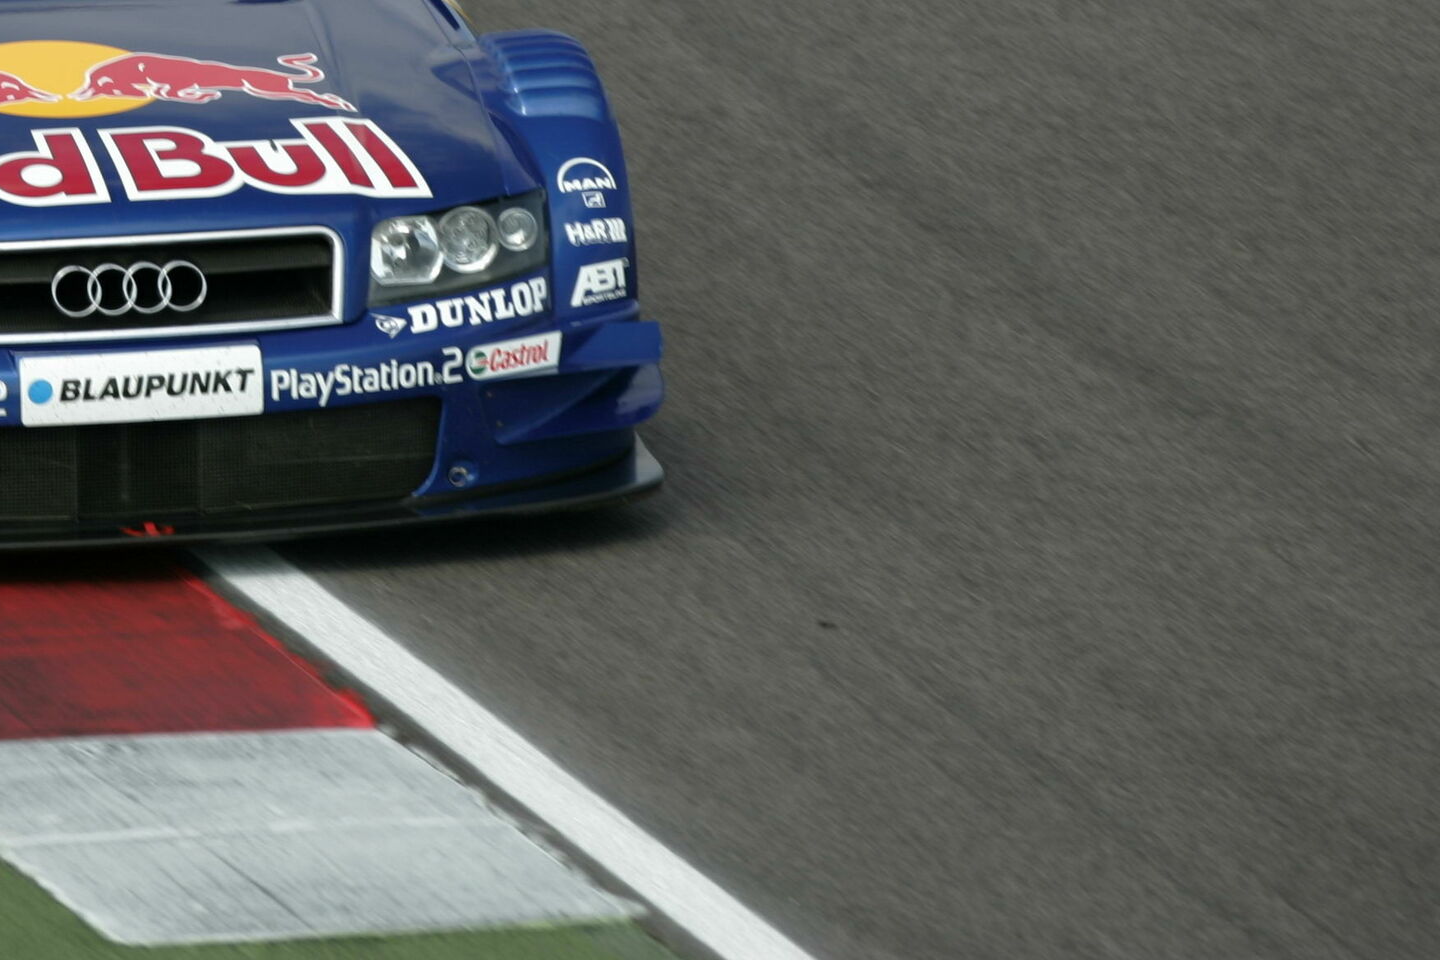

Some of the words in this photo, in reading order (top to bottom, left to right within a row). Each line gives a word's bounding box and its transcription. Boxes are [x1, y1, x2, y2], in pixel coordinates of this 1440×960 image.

[99, 117, 431, 200] Bull
[563, 176, 612, 193] MAN
[571, 257, 628, 308] ABT
[408, 276, 548, 335] DUNLOP
[489, 339, 549, 373] Castrol
[60, 368, 254, 403] BLAUPUNKT
